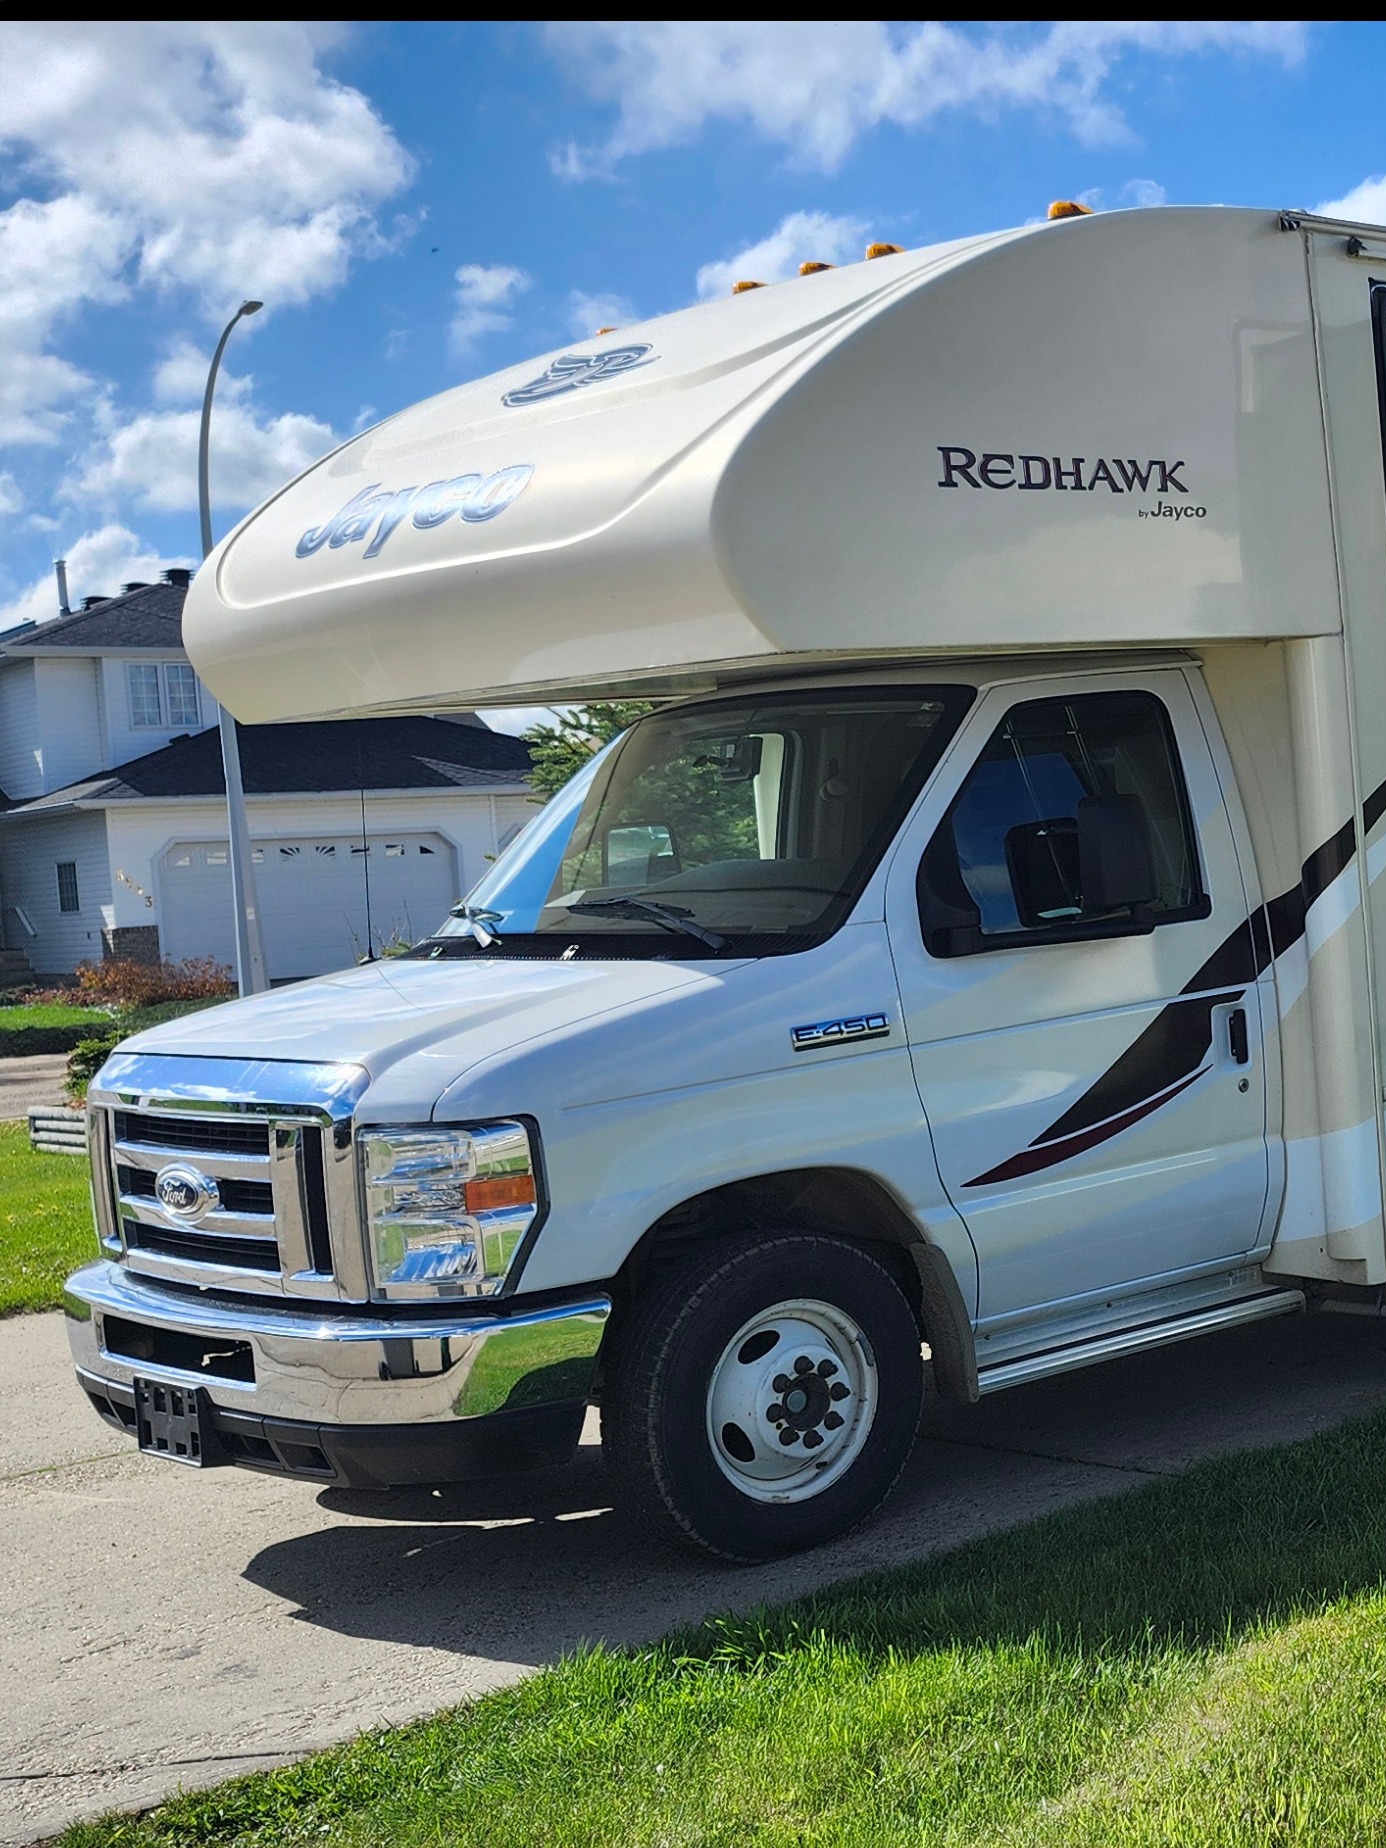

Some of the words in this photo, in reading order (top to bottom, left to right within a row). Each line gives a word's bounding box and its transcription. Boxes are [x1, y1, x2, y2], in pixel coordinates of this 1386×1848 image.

[295, 463, 535, 559] Jayco
[1138, 510, 1149, 520] by
[1150, 501, 1207, 521] Jayco
[794, 1014, 888, 1043] E-450
[162, 1178, 188, 1205] Ford
